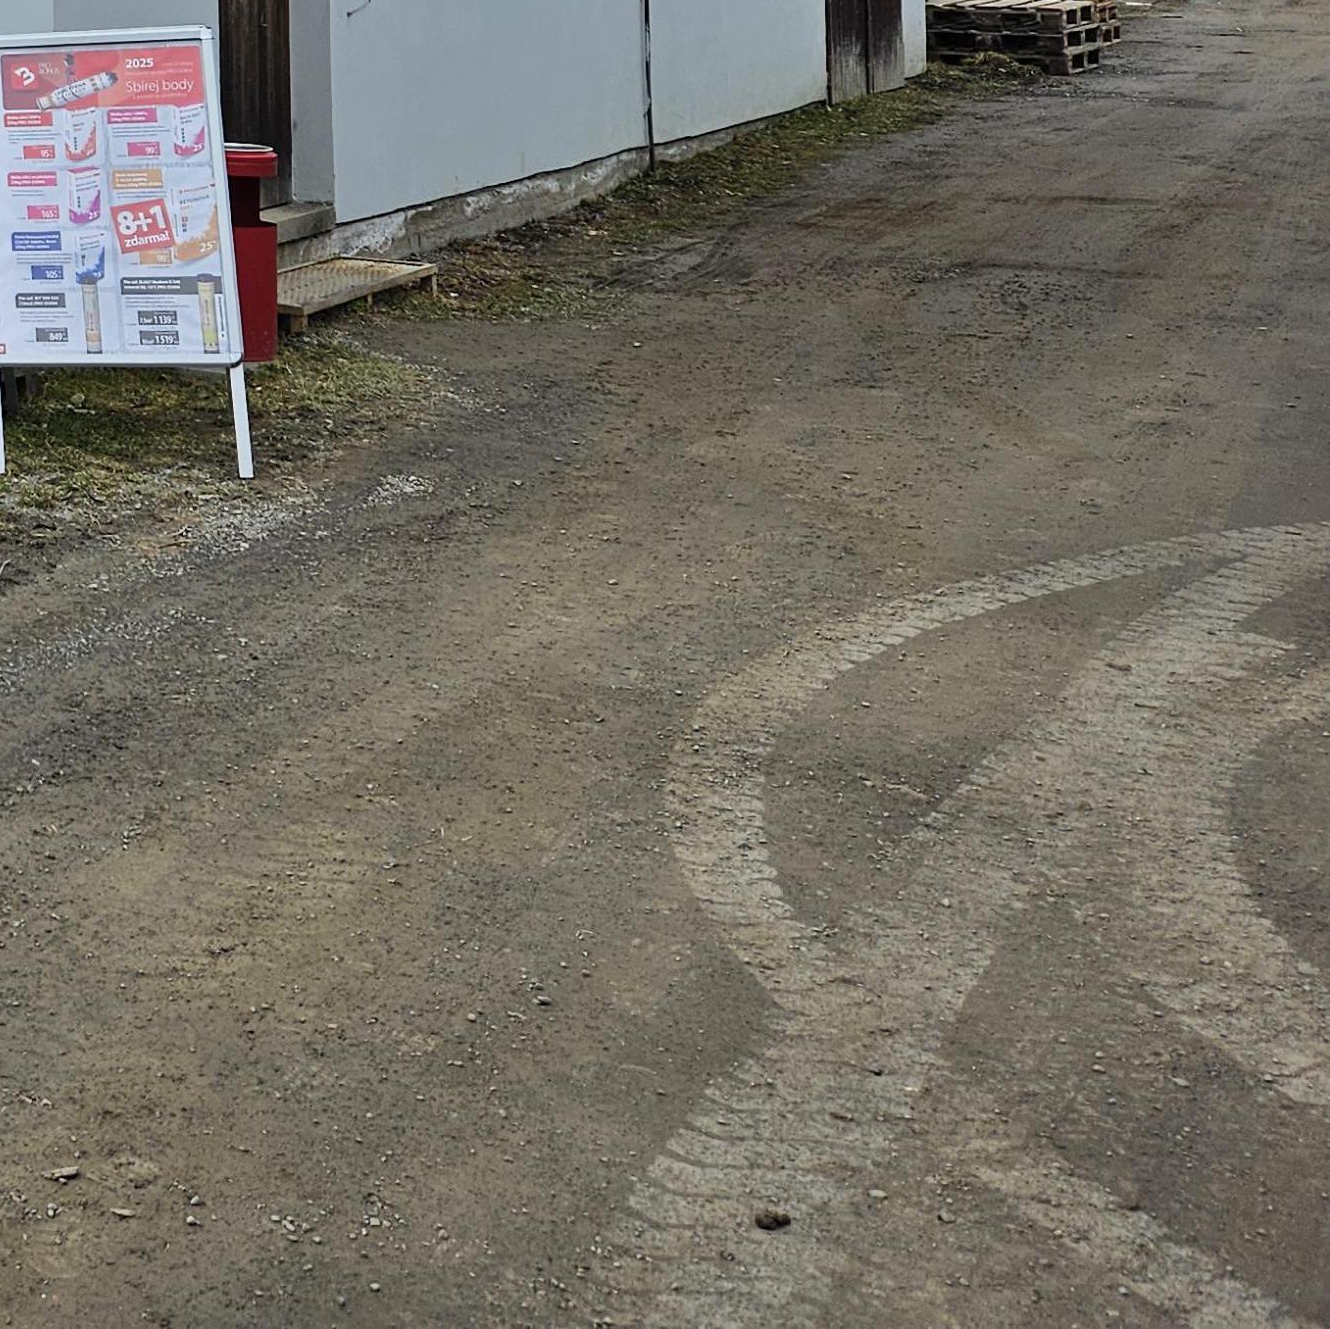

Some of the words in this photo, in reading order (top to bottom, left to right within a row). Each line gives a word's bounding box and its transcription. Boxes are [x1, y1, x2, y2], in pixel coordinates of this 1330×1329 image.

[125, 58, 155, 69] 2025
[162, 79, 195, 92] body
[117, 205, 166, 235] 8+1
[124, 230, 171, 248] zdarma!
